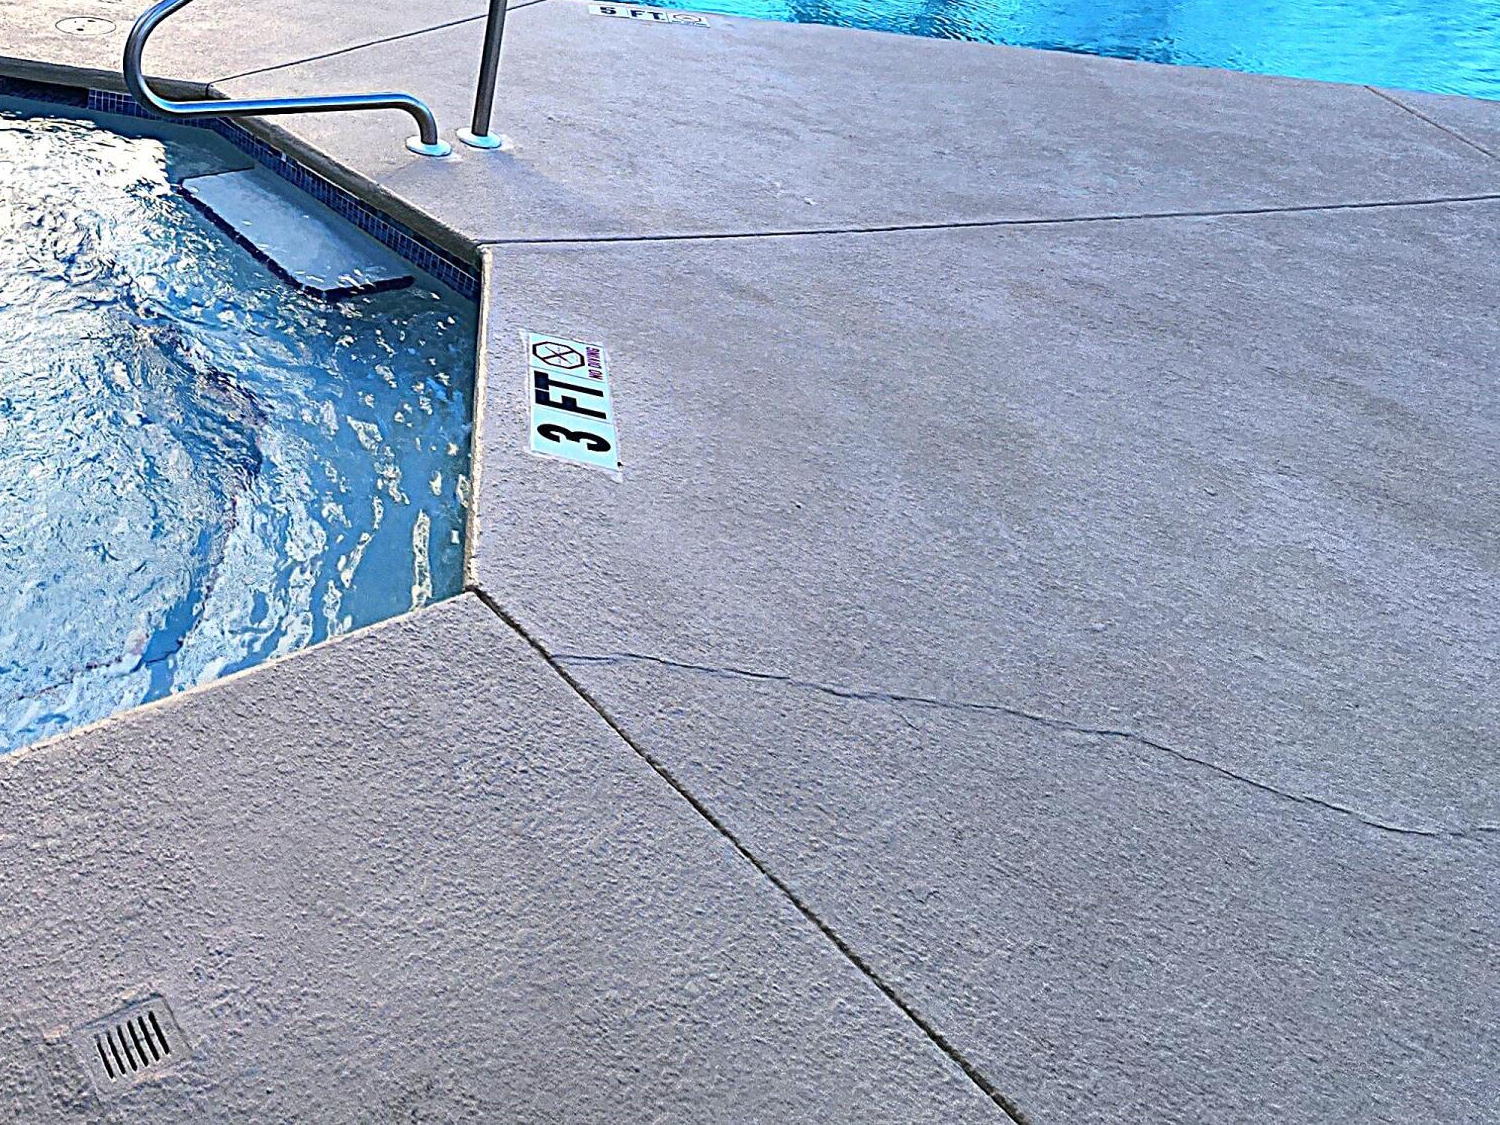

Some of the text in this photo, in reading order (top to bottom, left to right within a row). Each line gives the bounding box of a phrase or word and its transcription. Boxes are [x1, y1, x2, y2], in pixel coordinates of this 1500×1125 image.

[630, 10, 663, 21] FT
[534, 370, 611, 452] 3 FT
